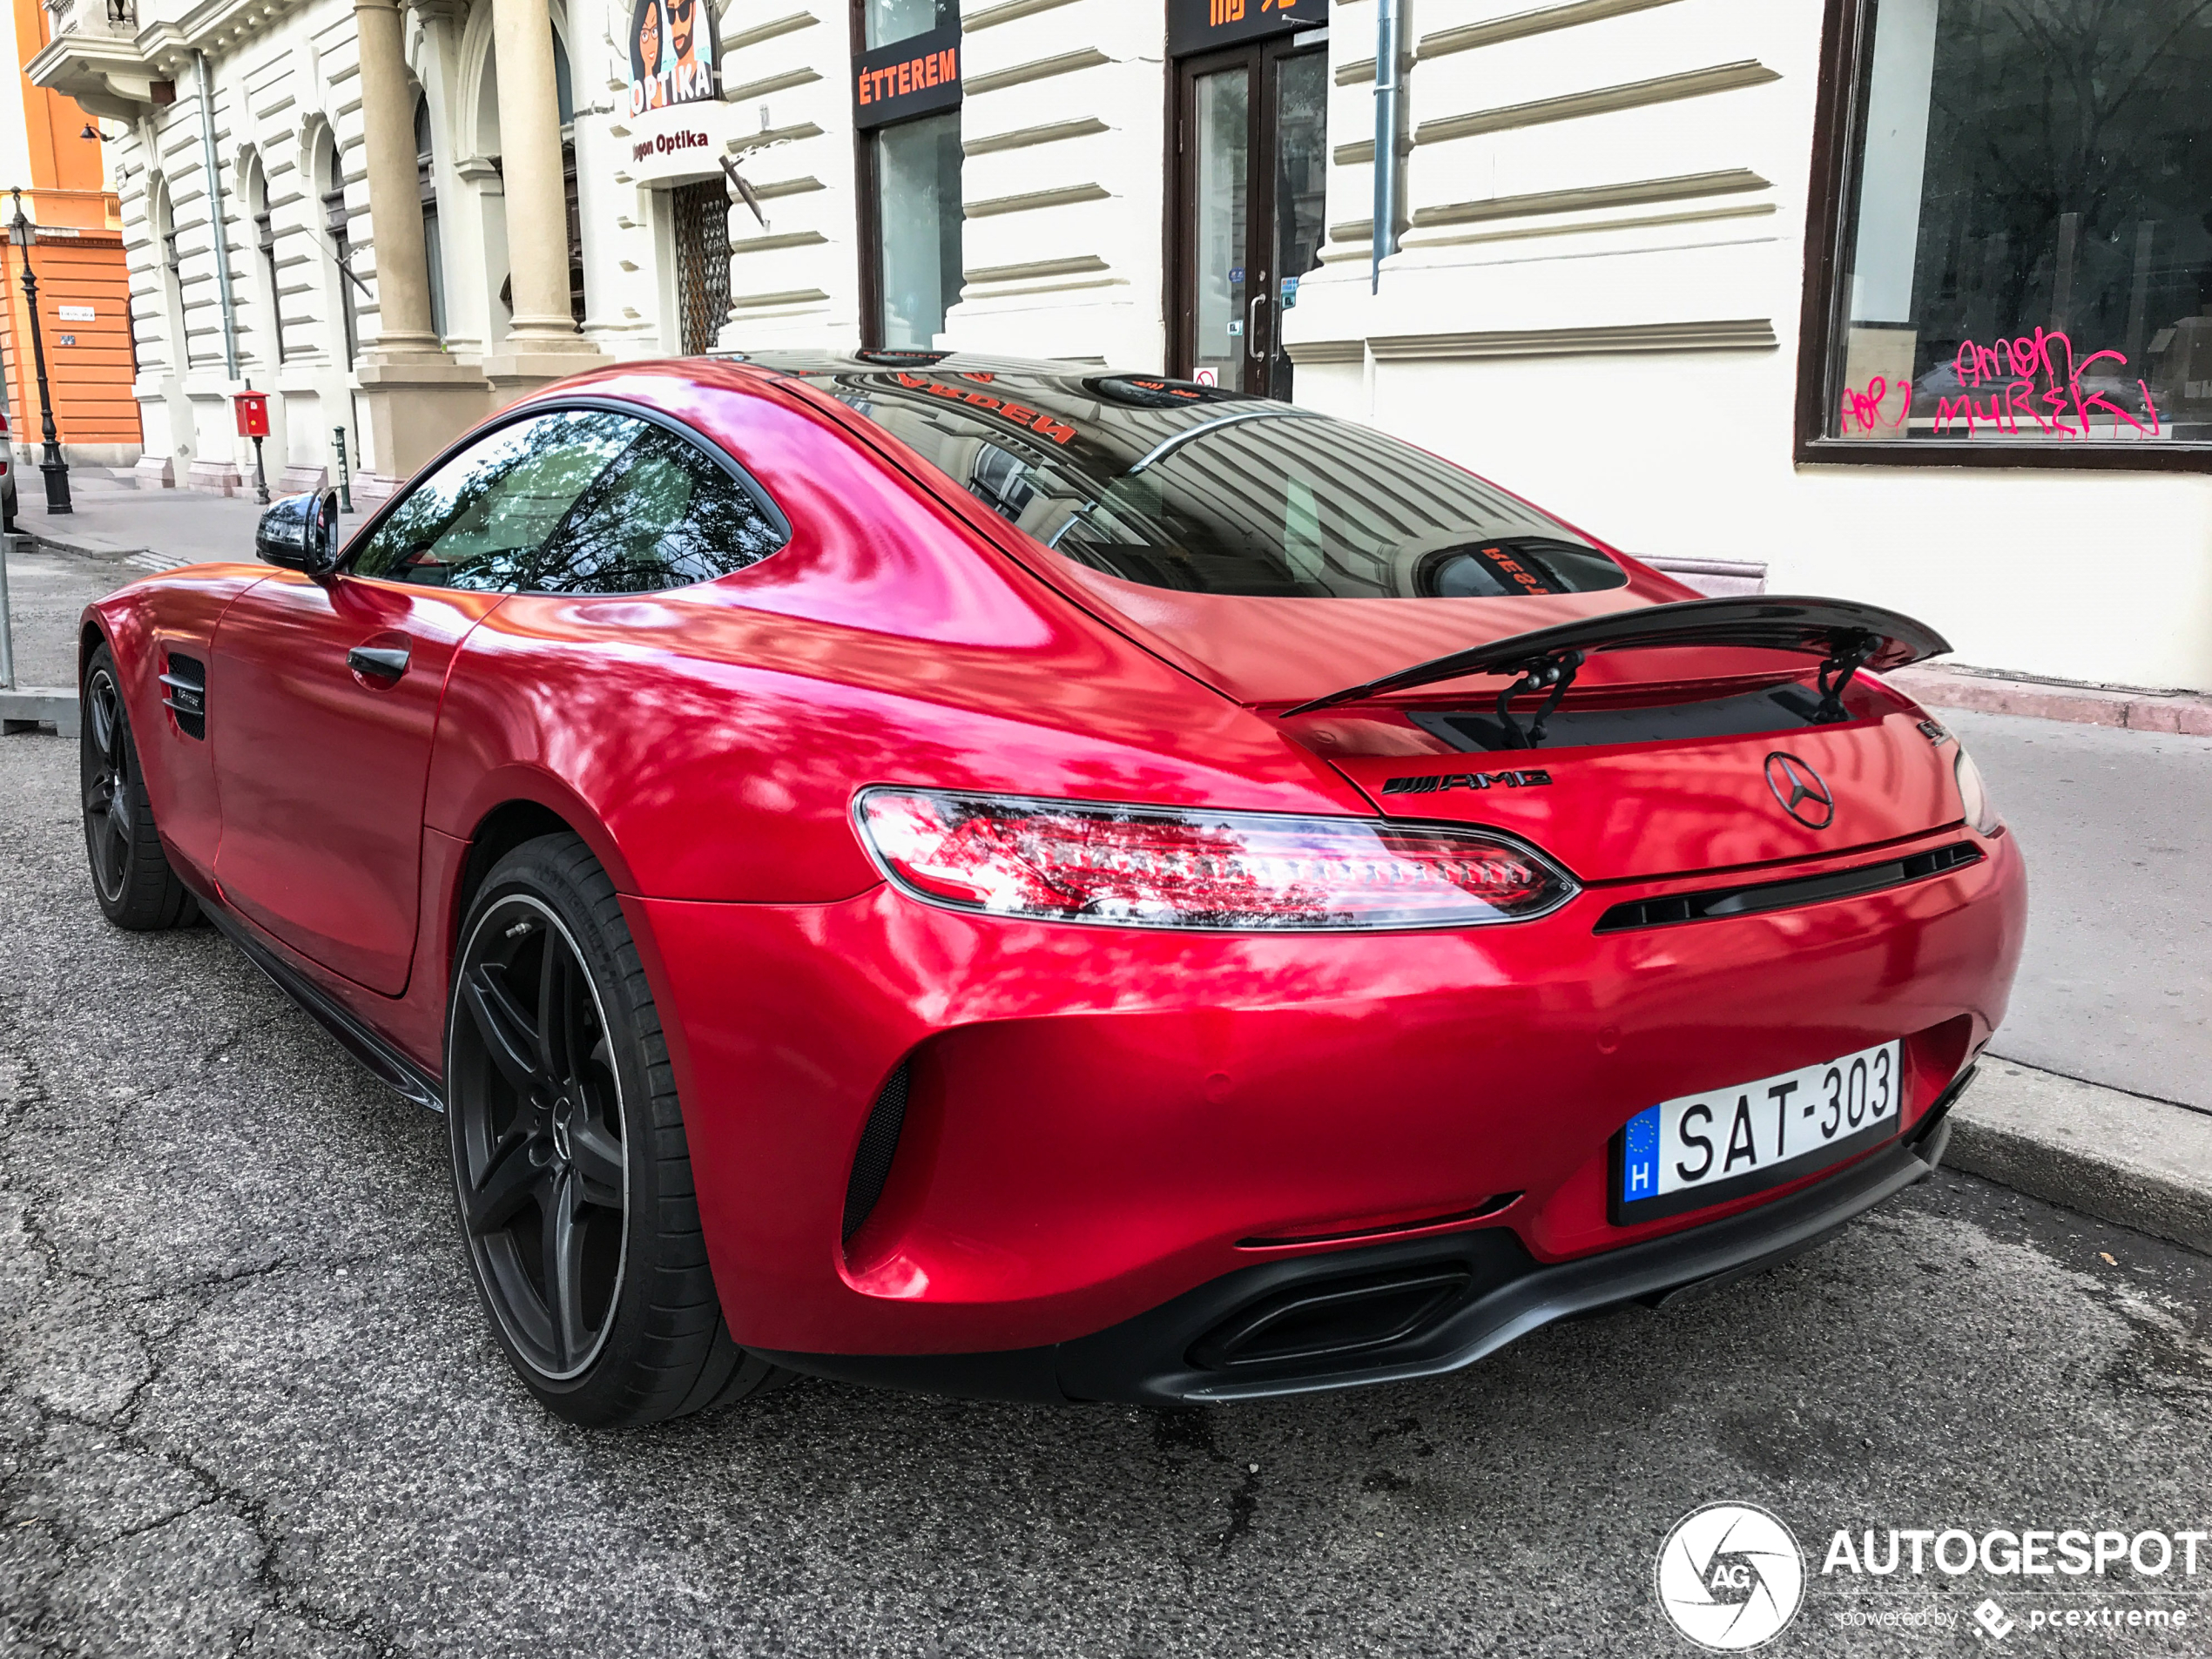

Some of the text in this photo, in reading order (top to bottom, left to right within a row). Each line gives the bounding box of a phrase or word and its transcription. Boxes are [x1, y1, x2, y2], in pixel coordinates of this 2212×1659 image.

[630, 60, 710, 115] OPTIKA
[859, 47, 956, 105] ÉTTEREM
[656, 129, 709, 155] Optika
[1438, 770, 1554, 792] AMG
[1676, 1048, 1890, 1182] SAT-303
[1631, 1162, 1649, 1191] H
